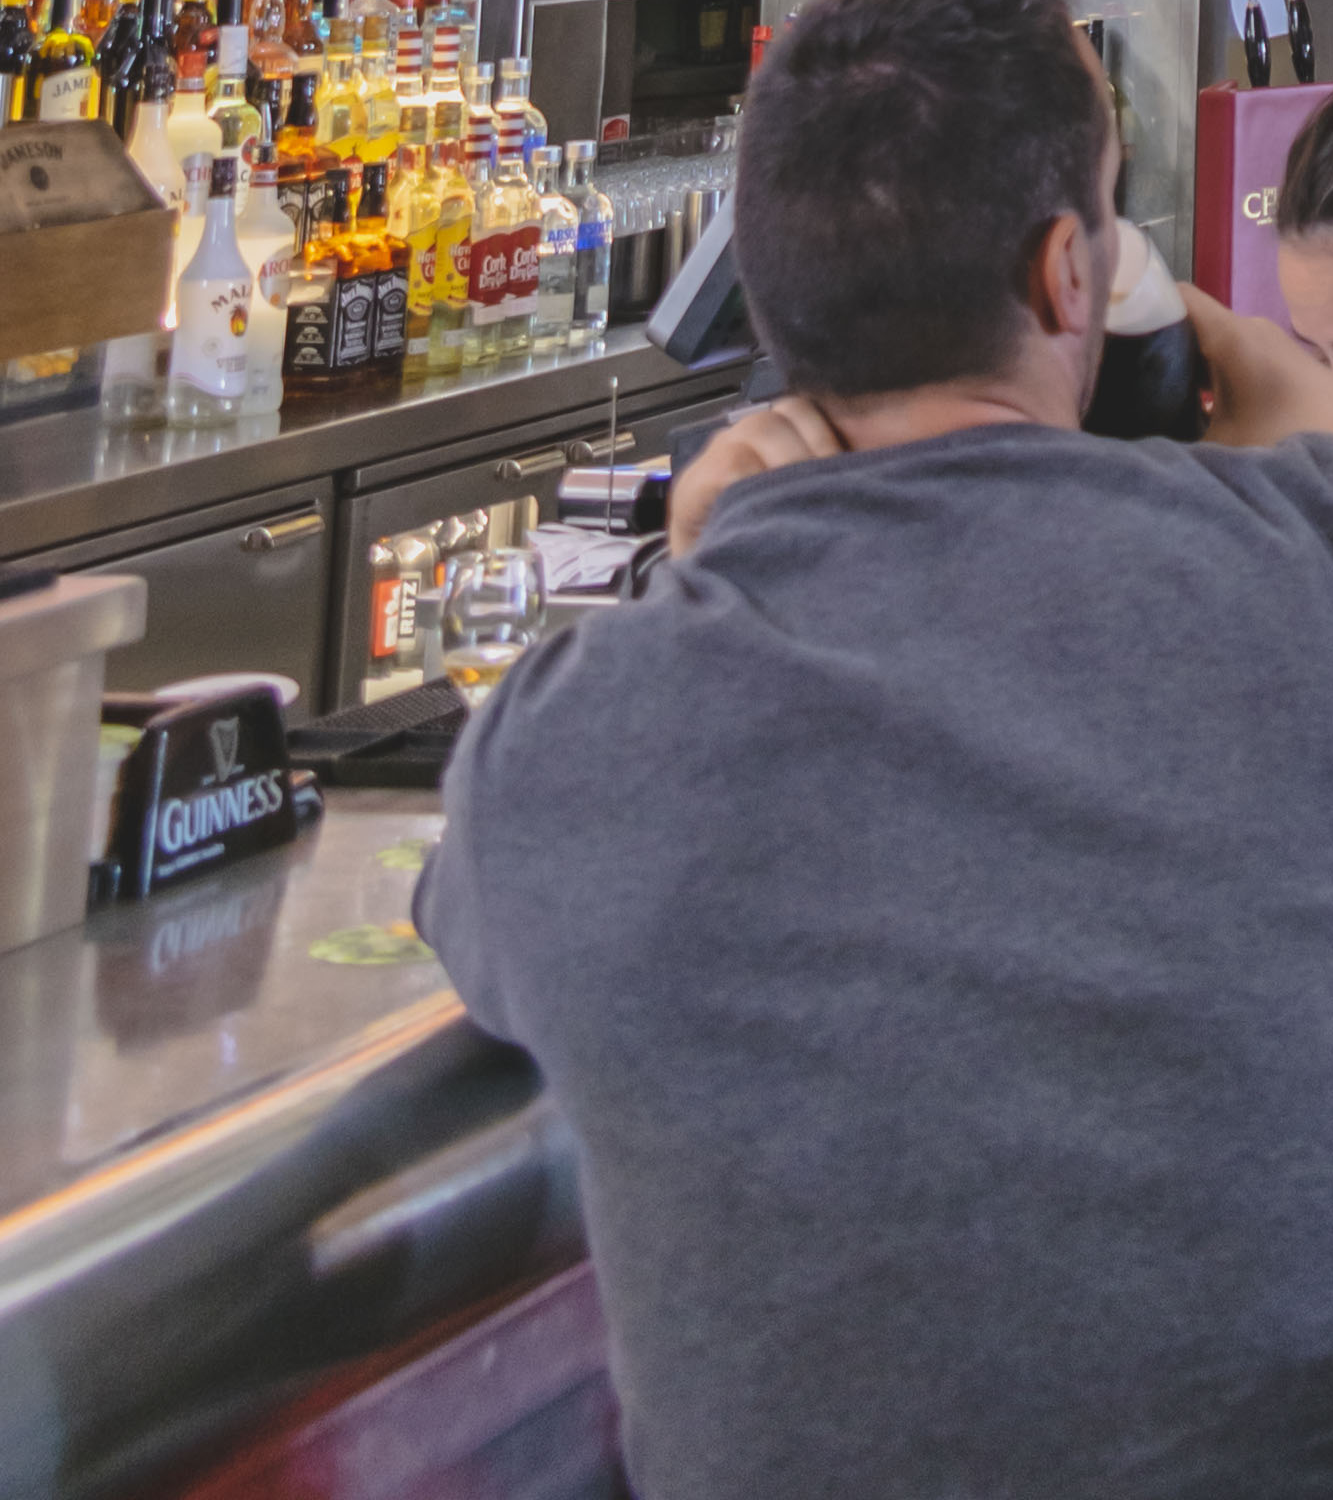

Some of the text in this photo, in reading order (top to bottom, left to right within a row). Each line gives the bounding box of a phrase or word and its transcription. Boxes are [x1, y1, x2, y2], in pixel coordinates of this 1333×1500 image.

[482, 255, 507, 276] Cork
[513, 246, 539, 266] Cork
[400, 581, 417, 635] RITZ
[162, 768, 283, 855] GUINNESS
